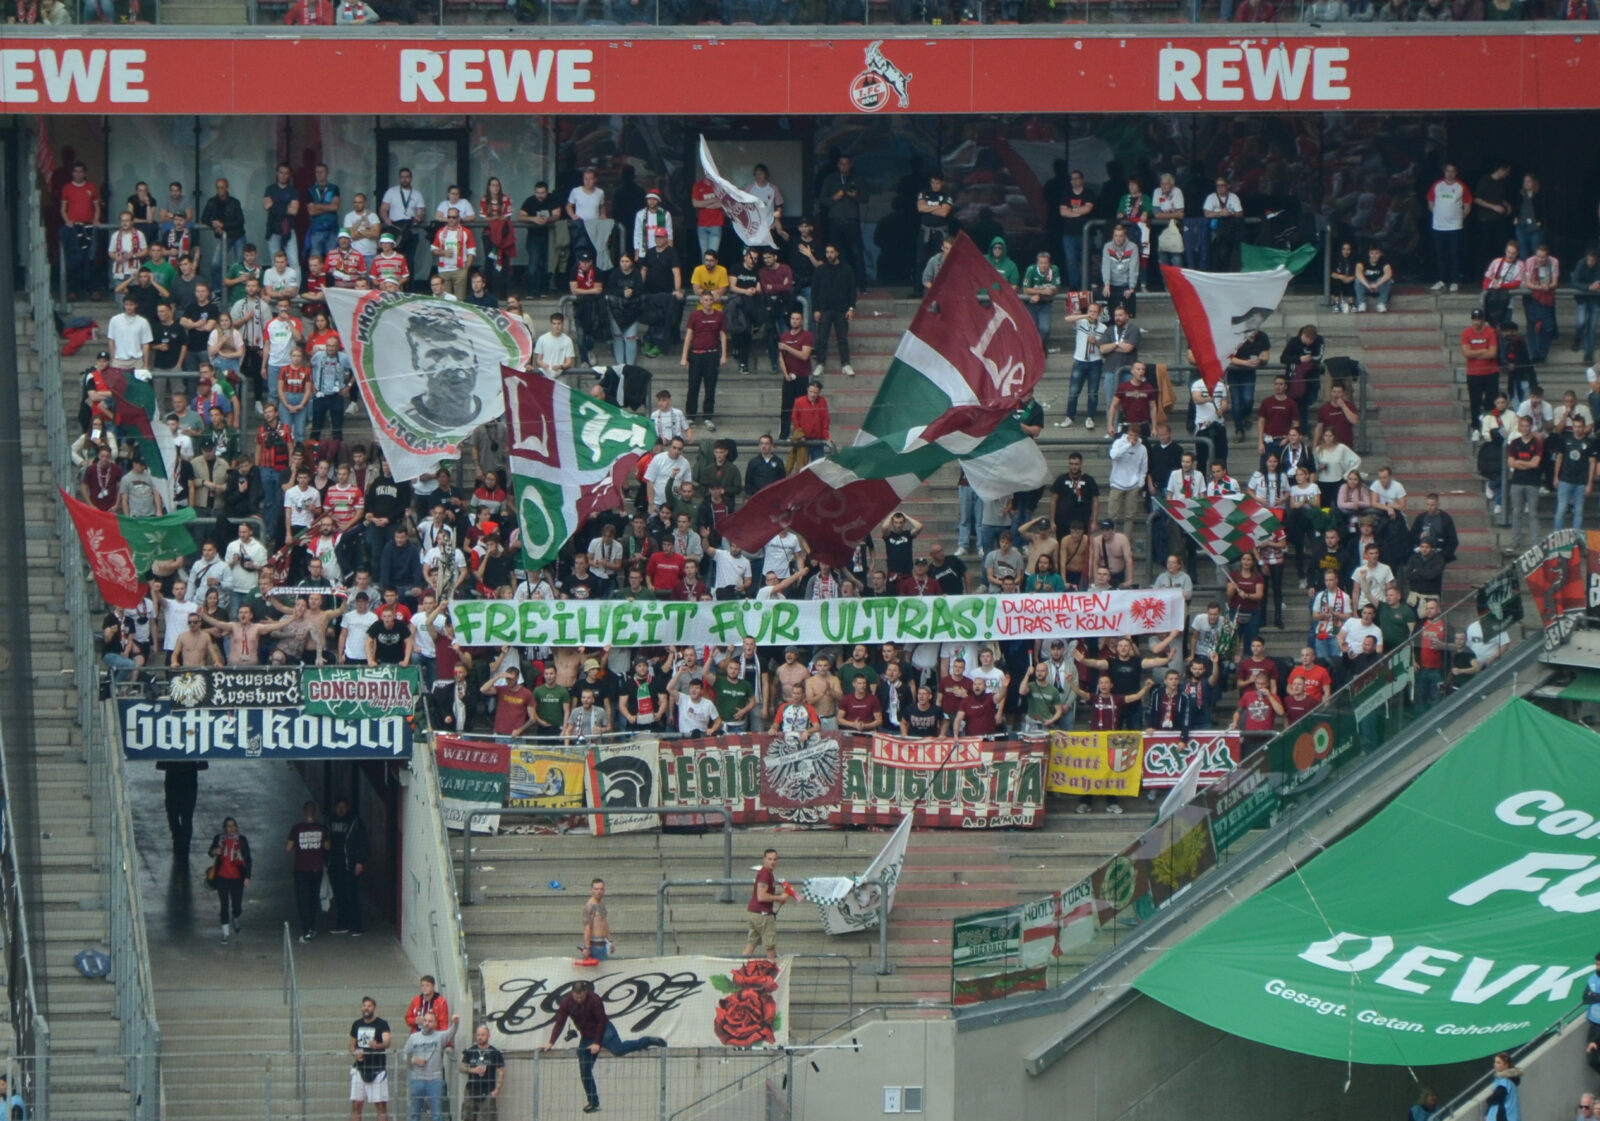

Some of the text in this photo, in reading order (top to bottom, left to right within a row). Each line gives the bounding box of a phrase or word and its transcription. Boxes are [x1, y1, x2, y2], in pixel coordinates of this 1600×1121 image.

[400, 49, 595, 102] REWE
[1158, 47, 1350, 101] REWE
[708, 601, 800, 645] FÜR
[820, 597, 997, 643] ULTRAS!
[996, 612, 1053, 636] ULTRAS
[1075, 611, 1124, 632] KÖLN!
[1001, 593, 1110, 614] DURCHHALTEN
[308, 680, 412, 702] CONCORDIA
[443, 747, 499, 765] WEITER
[874, 738, 981, 763] KICKERS
[660, 755, 761, 801] LEGIO
[844, 758, 1042, 804] AUGUSTA
[990, 814, 1034, 827] MMVII
[1296, 931, 1598, 1006] DEVK
[1263, 978, 1532, 1036] Gesagt. Getan. Geholfen.
